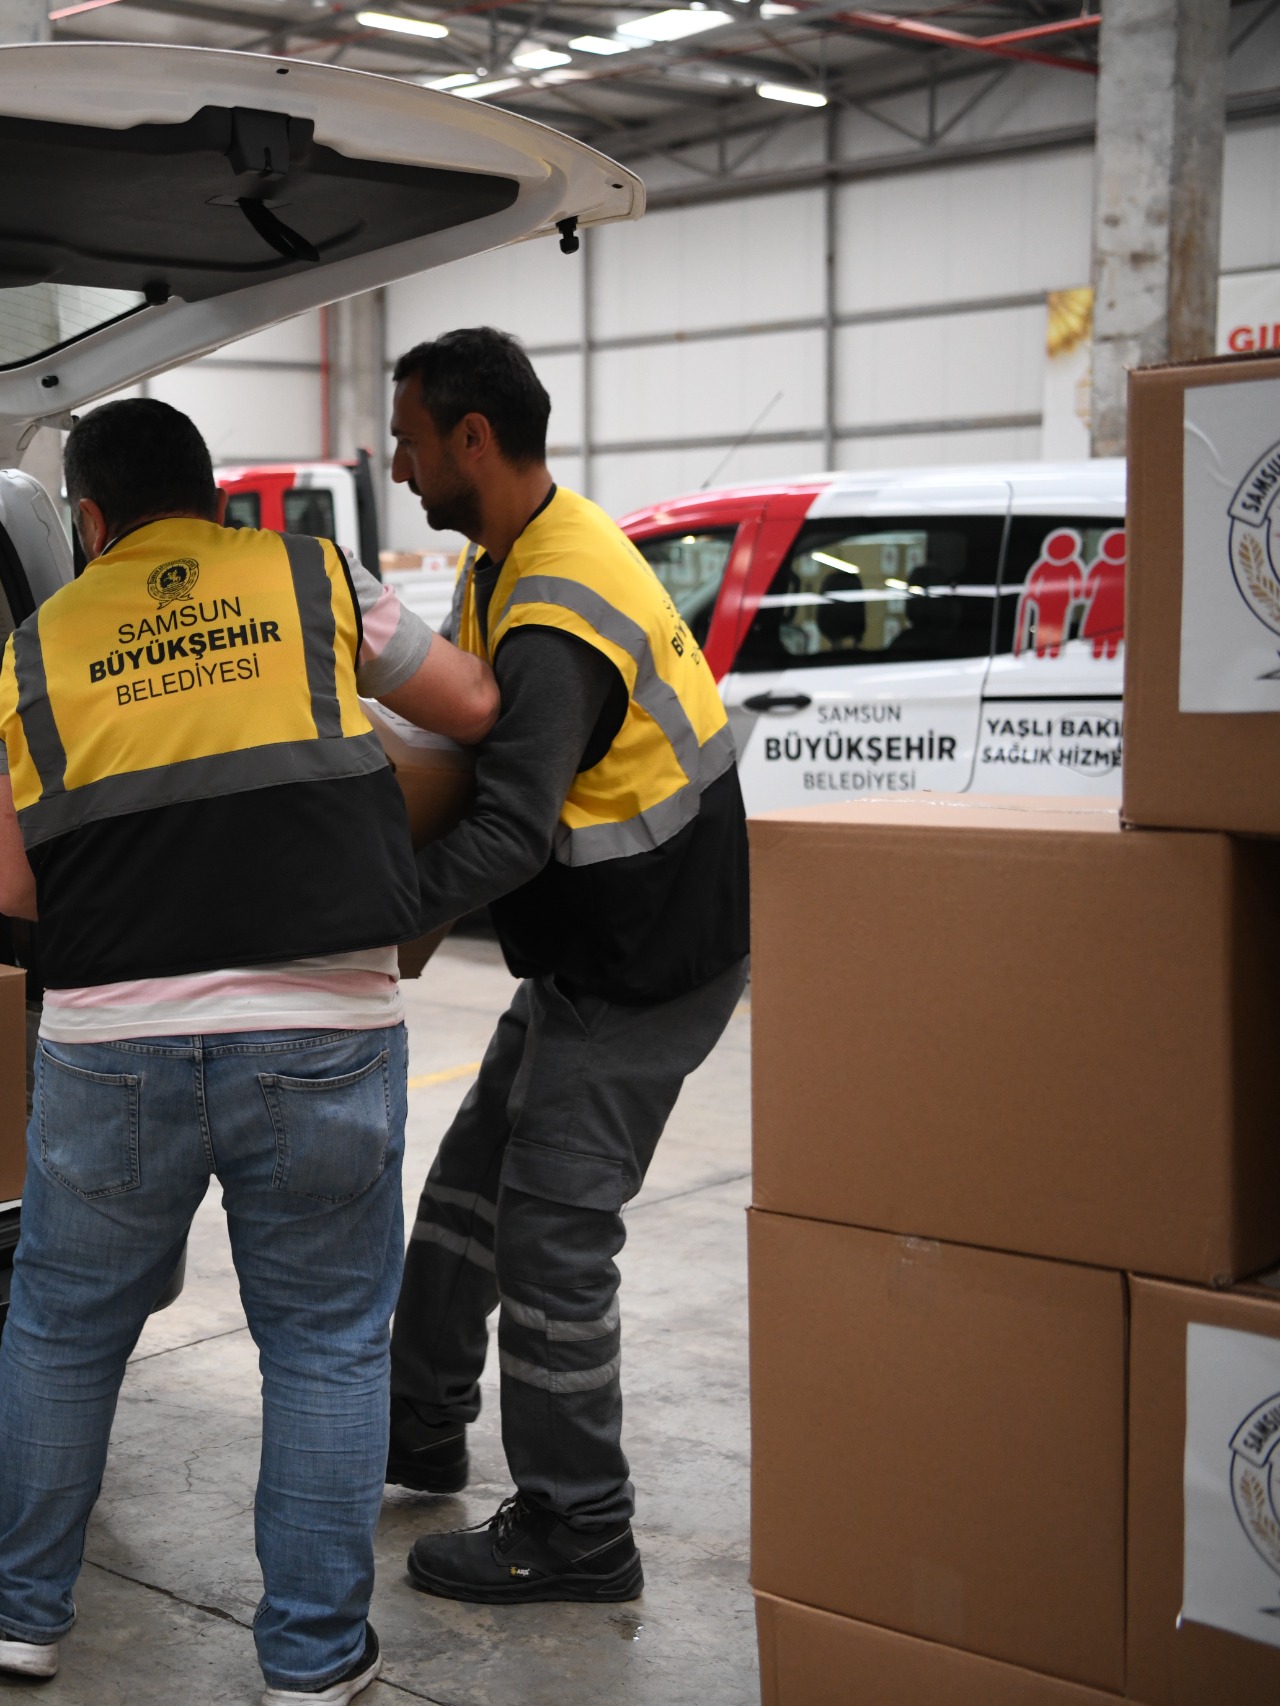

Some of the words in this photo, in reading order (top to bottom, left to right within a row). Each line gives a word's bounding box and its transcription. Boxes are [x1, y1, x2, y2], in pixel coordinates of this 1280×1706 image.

[1228, 325, 1280, 352] GI
[1241, 452, 1280, 513] SAMSU
[118, 597, 242, 644] SAMSUN
[89, 617, 282, 684] BÜYÜKŞEHİR
[116, 653, 260, 706] BELEDİYESİ
[817, 705, 901, 723] SAMSUN
[987, 719, 1052, 740] YAŞLI
[1060, 719, 1123, 737] BAKI
[765, 730, 956, 764] BÜYÜKŞEHİR
[982, 744, 1050, 763] SAĞLIK
[803, 770, 916, 790] BELEDİYESİ
